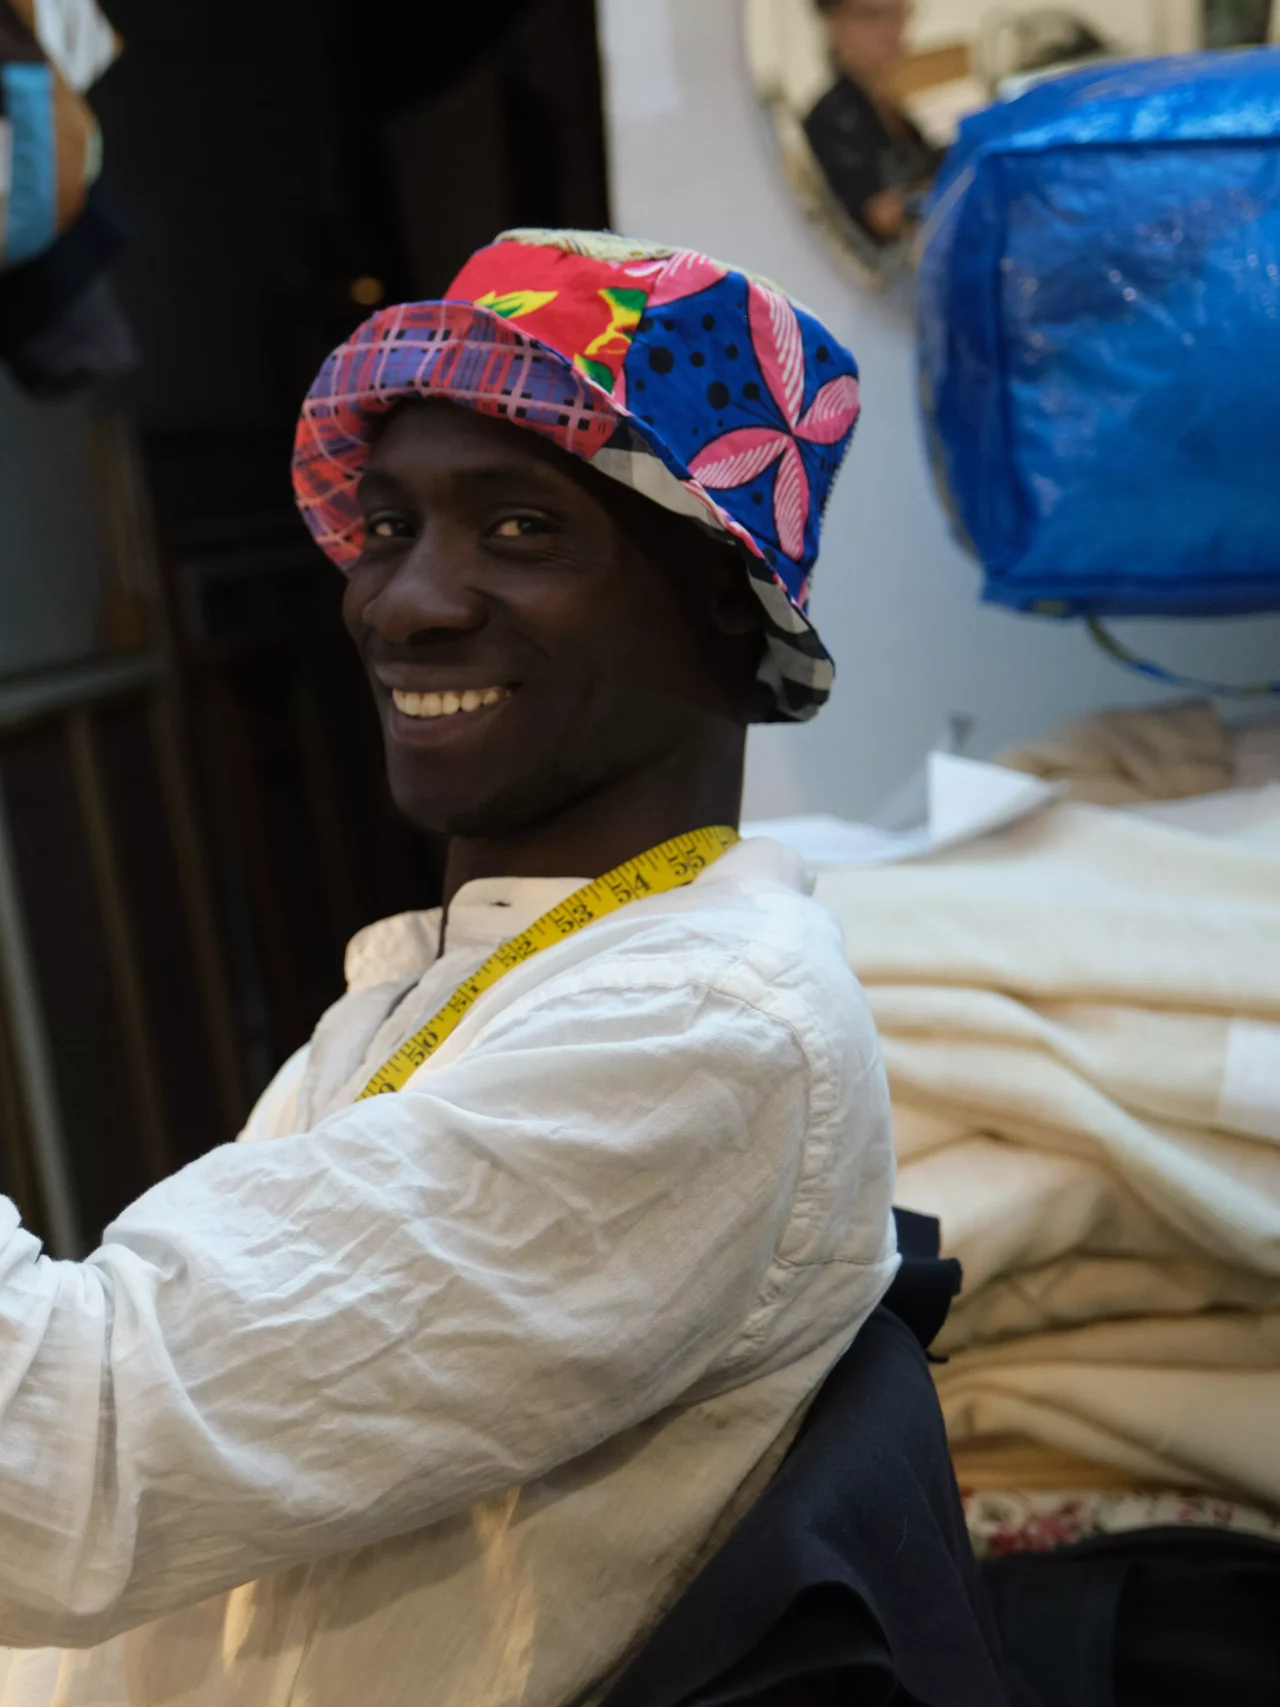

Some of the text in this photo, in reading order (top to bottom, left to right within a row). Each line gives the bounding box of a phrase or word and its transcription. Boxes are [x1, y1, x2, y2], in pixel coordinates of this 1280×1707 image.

[407, 1032, 439, 1067] 50
[498, 940, 538, 967] 52
[555, 903, 594, 933] 53
[611, 872, 652, 903] 54
[668, 847, 706, 876] 55
